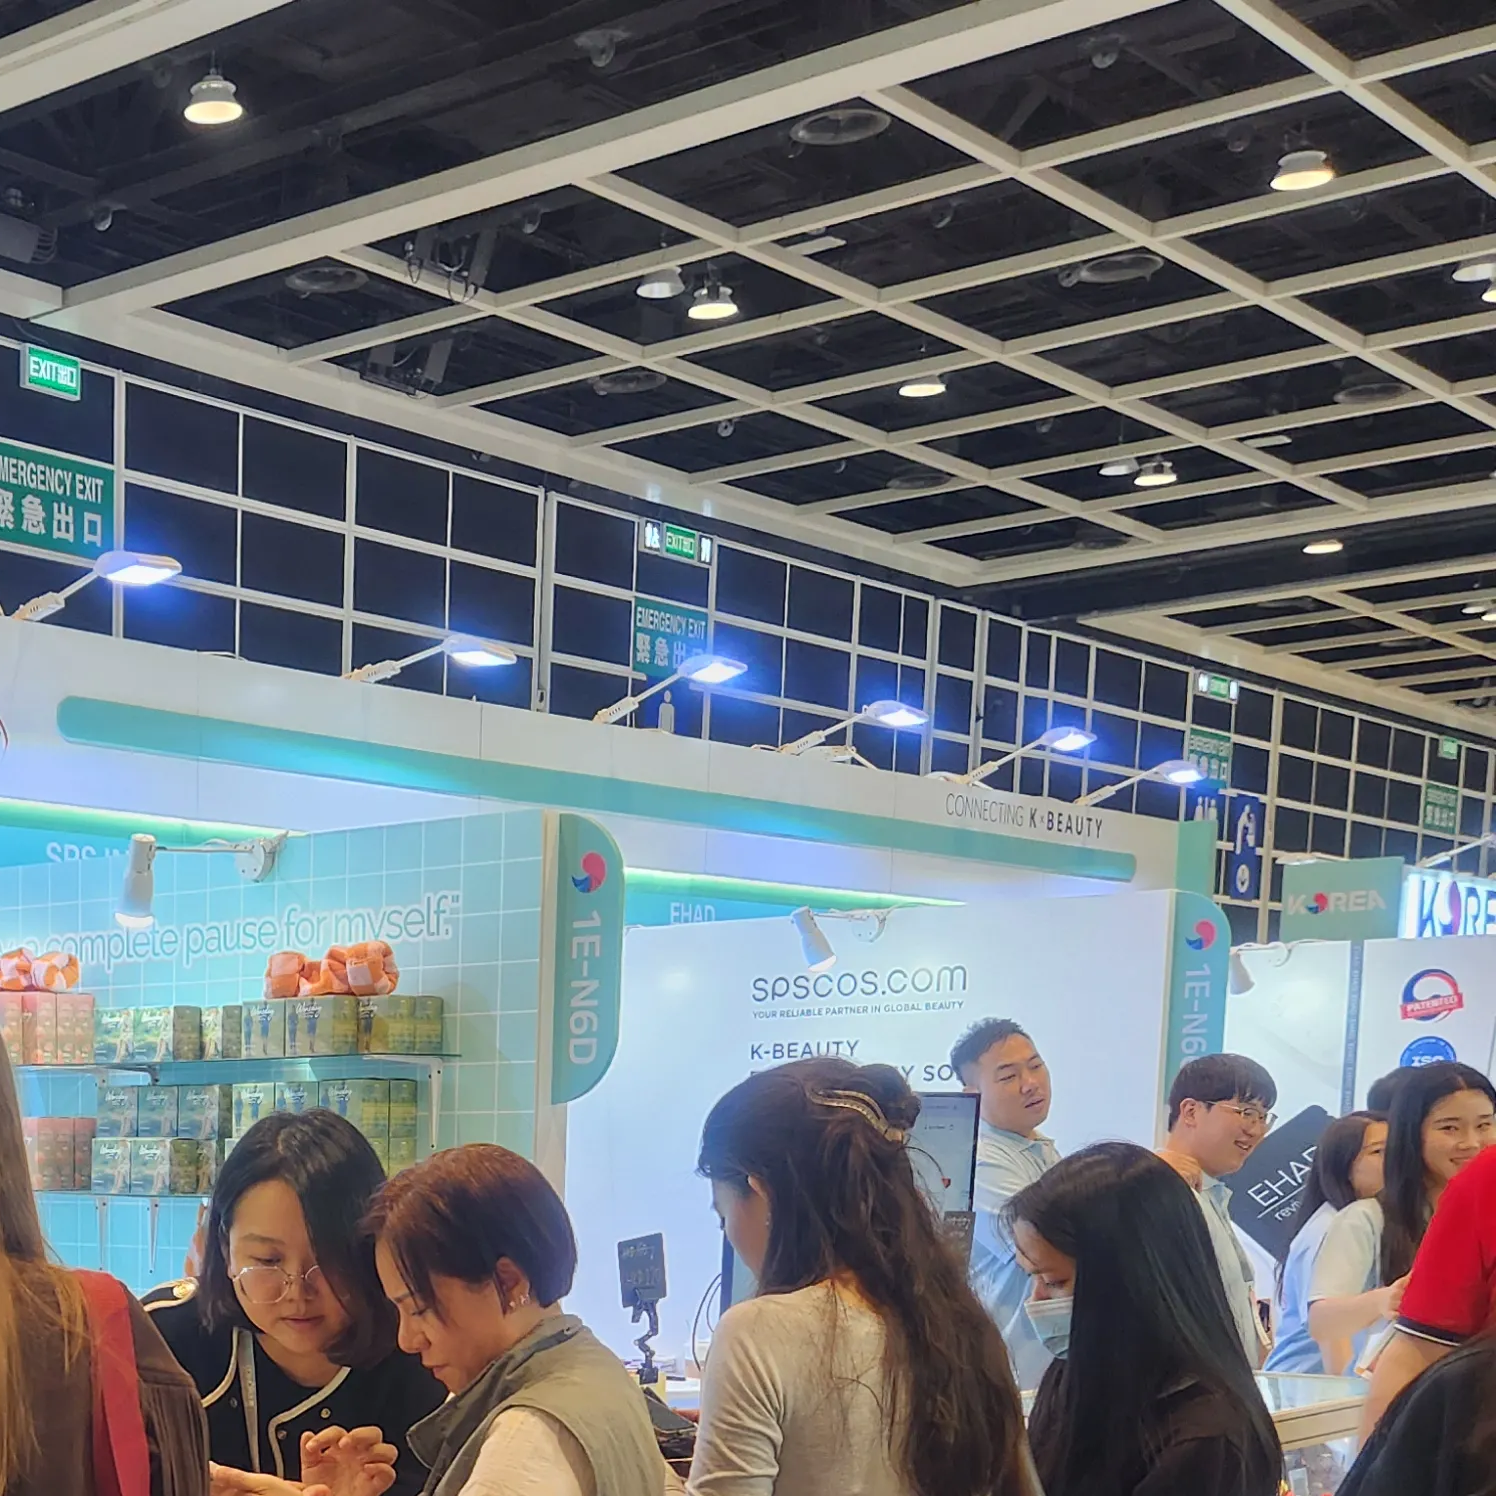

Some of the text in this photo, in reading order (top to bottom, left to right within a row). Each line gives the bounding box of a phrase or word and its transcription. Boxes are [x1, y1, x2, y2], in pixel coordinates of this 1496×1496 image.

[75, 474, 104, 504] EXIT
[636, 606, 706, 640] EMERGENCY EXIT
[945, 793, 1024, 828] CONNECTING
[1287, 889, 1387, 916] KOREA
[45, 926, 179, 973] complete
[186, 919, 278, 967] pause
[285, 906, 328, 946] for
[568, 910, 602, 1065] 1E-N6D
[751, 964, 968, 1003] spscos.com
[753, 1000, 964, 1019] YOUR RELIABLE PARTNER IN GLOBAL BEAUTY
[750, 1039, 860, 1061] K-BEAUTY
